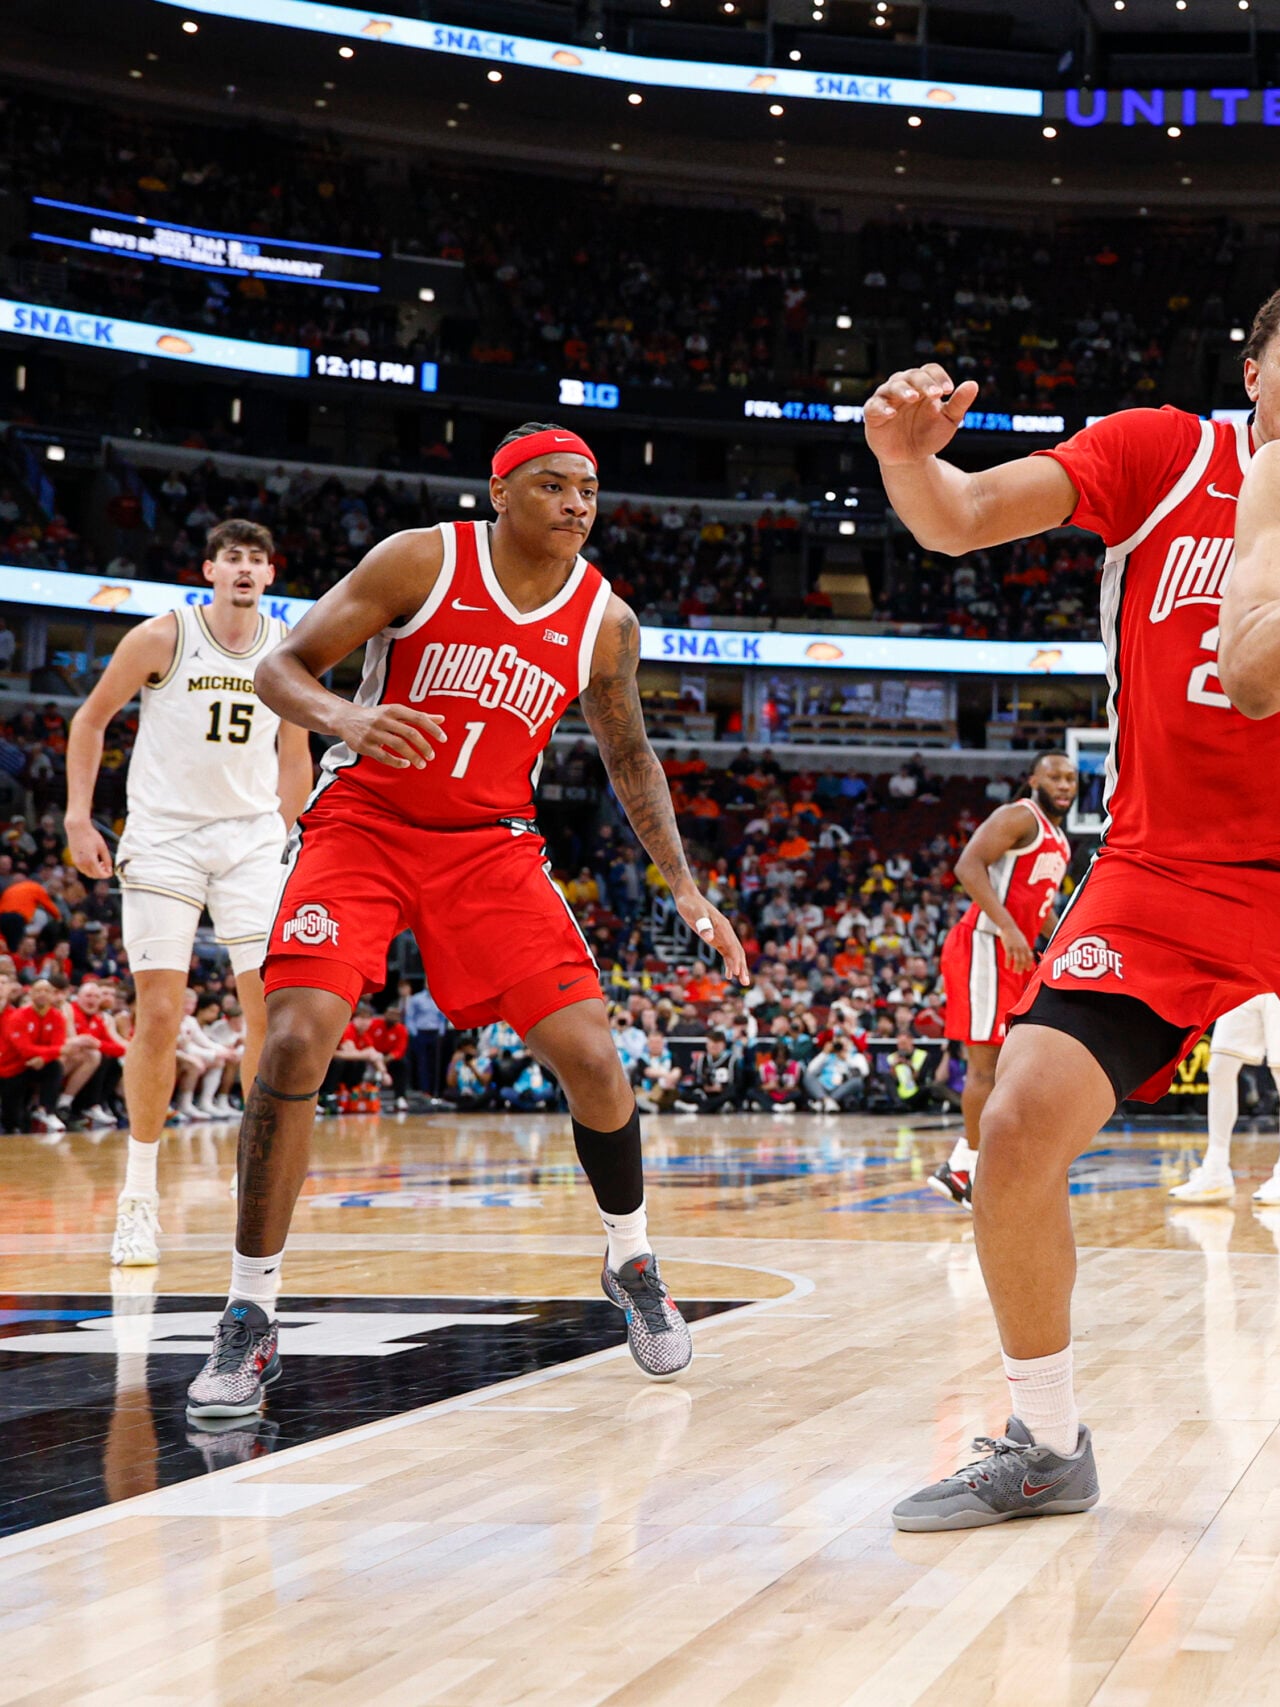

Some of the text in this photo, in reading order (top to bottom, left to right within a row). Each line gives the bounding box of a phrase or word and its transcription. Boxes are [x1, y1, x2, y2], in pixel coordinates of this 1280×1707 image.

[434, 28, 515, 58] SNACK
[815, 77, 892, 99] SNACK
[228, 253, 325, 279] TOURNAMENT
[13, 308, 113, 343] SNACK
[315, 354, 415, 385] 12:15 PM
[833, 405, 865, 423] 3PT
[1012, 415, 1065, 433] BONUS
[662, 634, 760, 659] SNACK
[187, 676, 257, 694] MICHIG
[205, 701, 255, 745] 15
[450, 721, 487, 779] 1
